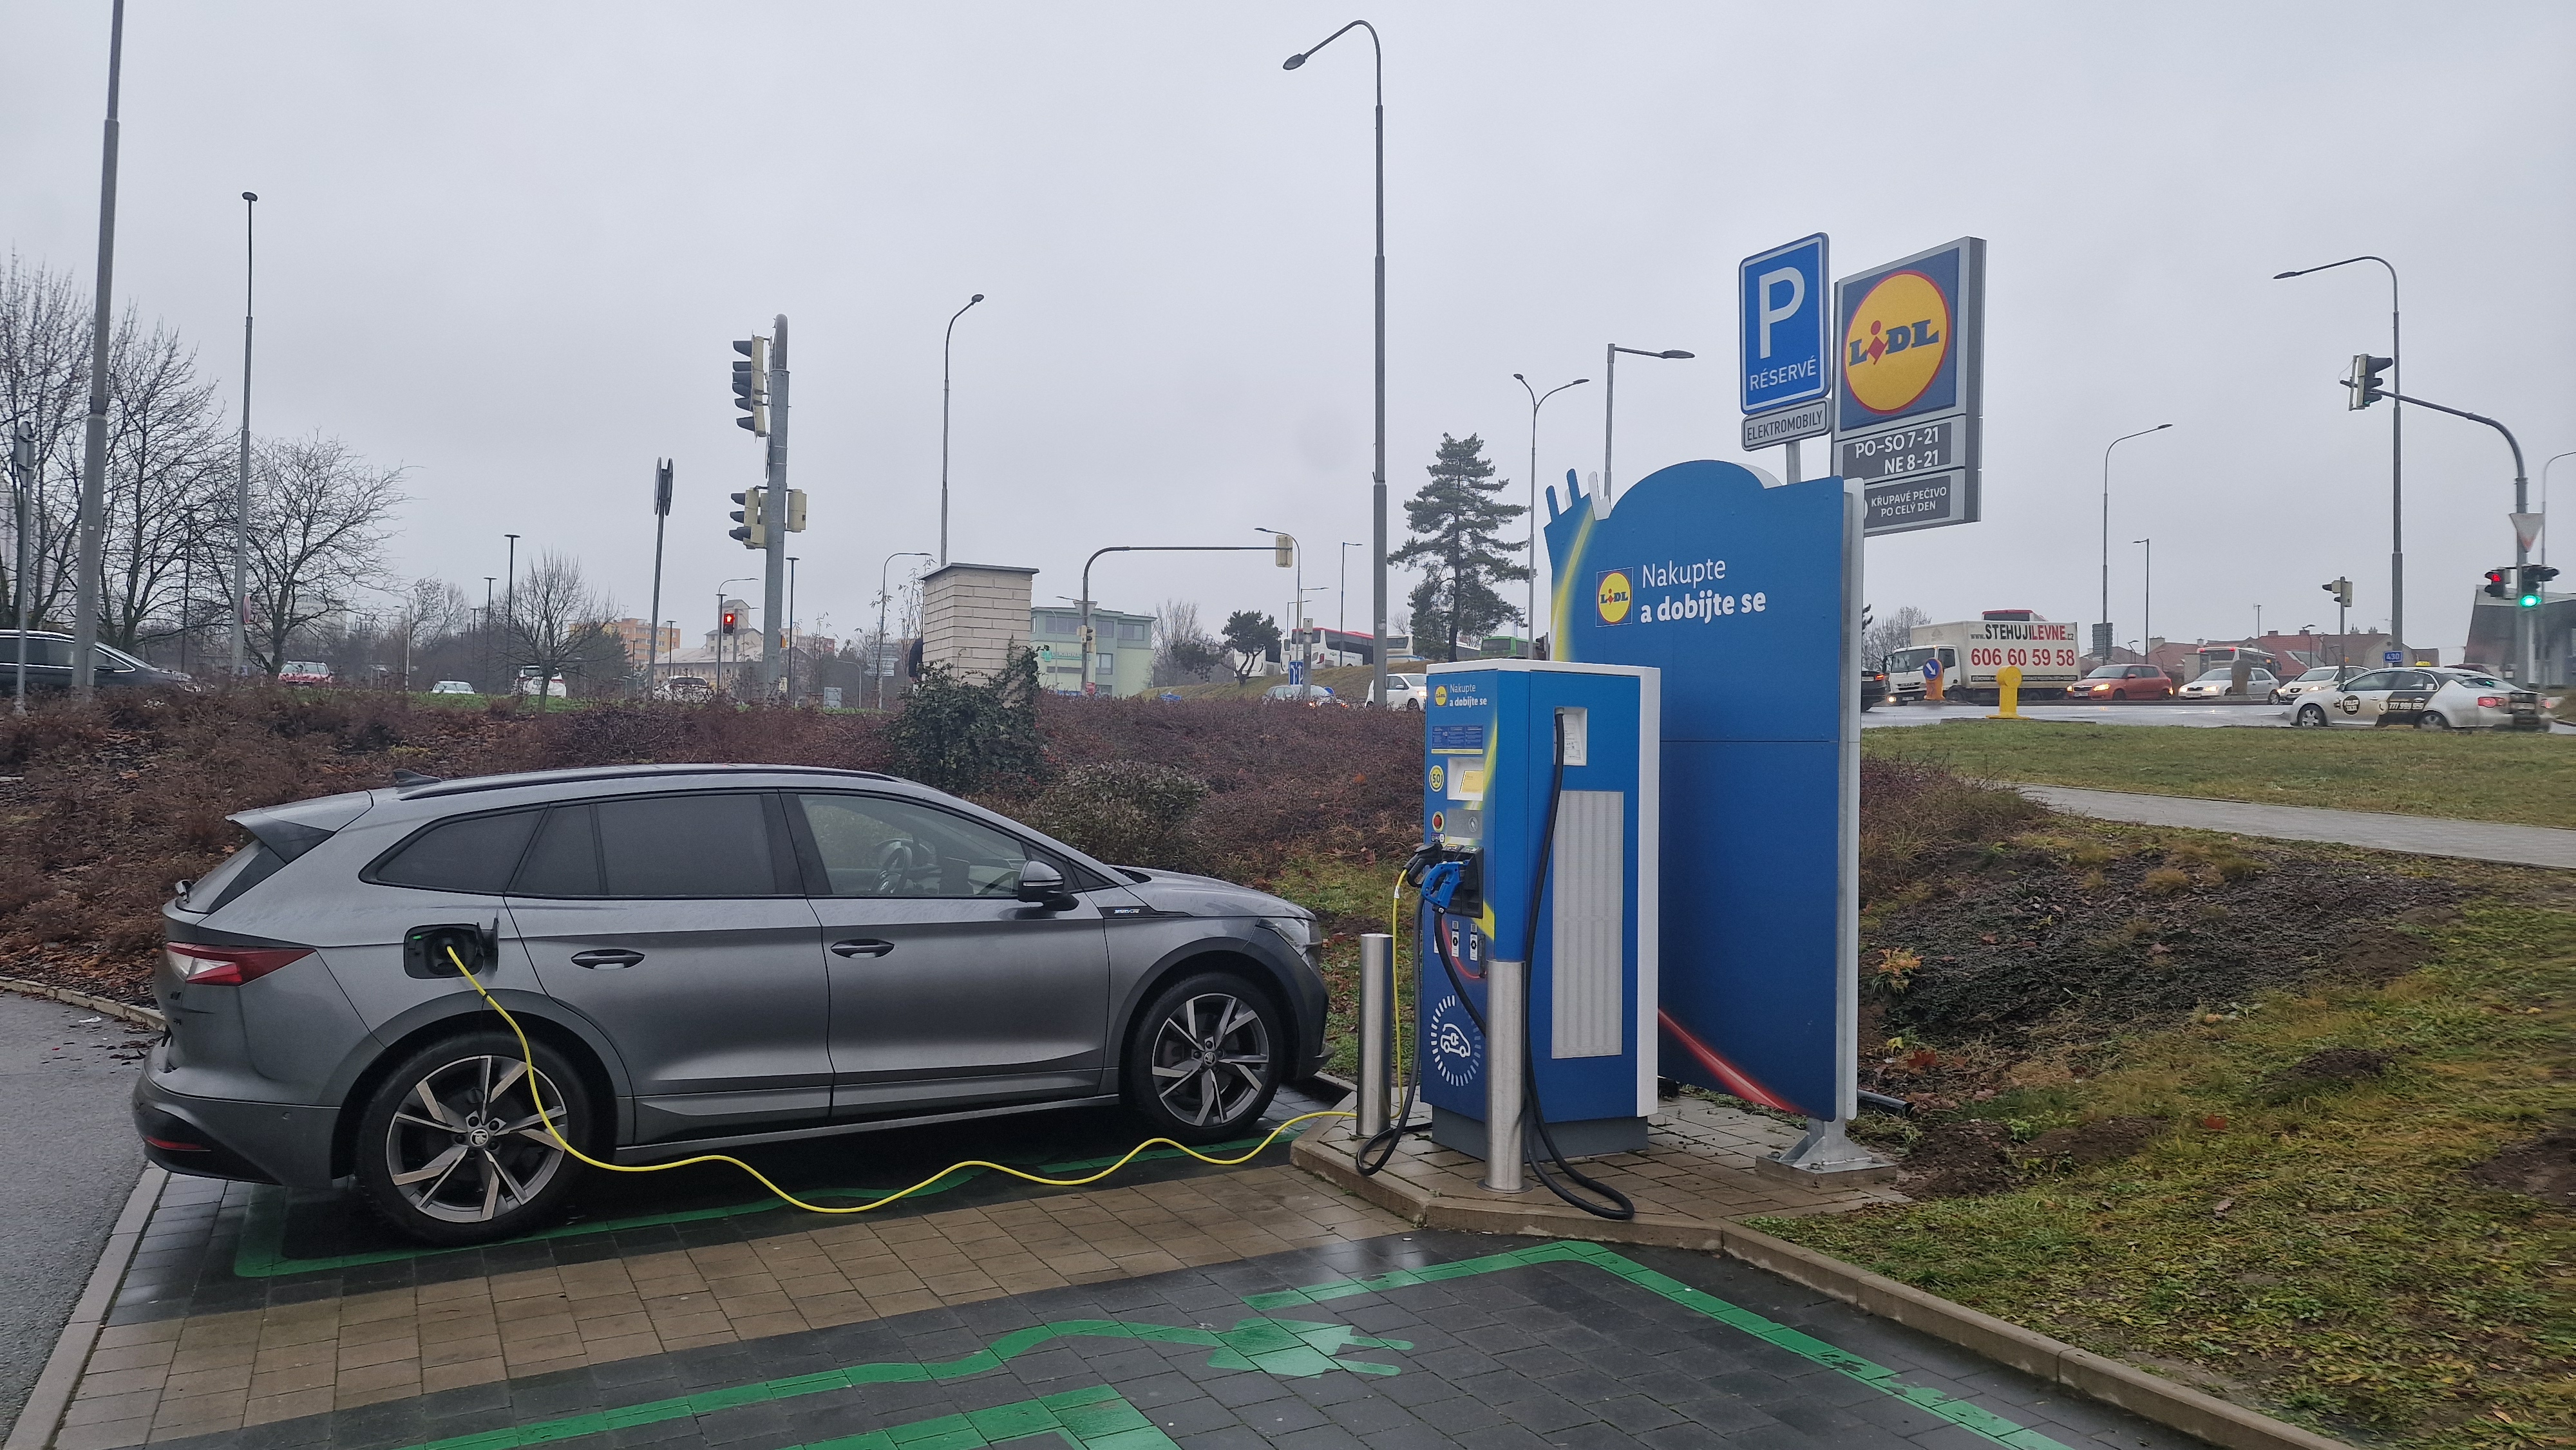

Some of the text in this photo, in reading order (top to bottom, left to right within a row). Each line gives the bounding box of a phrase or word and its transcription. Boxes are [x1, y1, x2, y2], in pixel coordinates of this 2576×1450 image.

[1759, 266, 1805, 359] P
[1750, 355, 1817, 391] RÉSERVÉ
[1747, 410, 1823, 441] ELEKTROMOBILY
[1855, 434, 1905, 458] PO-SO
[1884, 456, 1904, 475] NE
[1871, 486, 1947, 507] KŘUPAVÉ PEČIVO
[1880, 500, 1936, 517] PO CELÝ DEN
[1642, 558, 1726, 588] Nakupte
[1640, 589, 1766, 624] a dobijte se
[1971, 648, 2075, 666] 606 60 59 58
[1450, 683, 1476, 694] Nakupte
[1454, 696, 1479, 708] dobijte
[1479, 697, 1487, 706] se
[1432, 773, 1441, 784] 50
